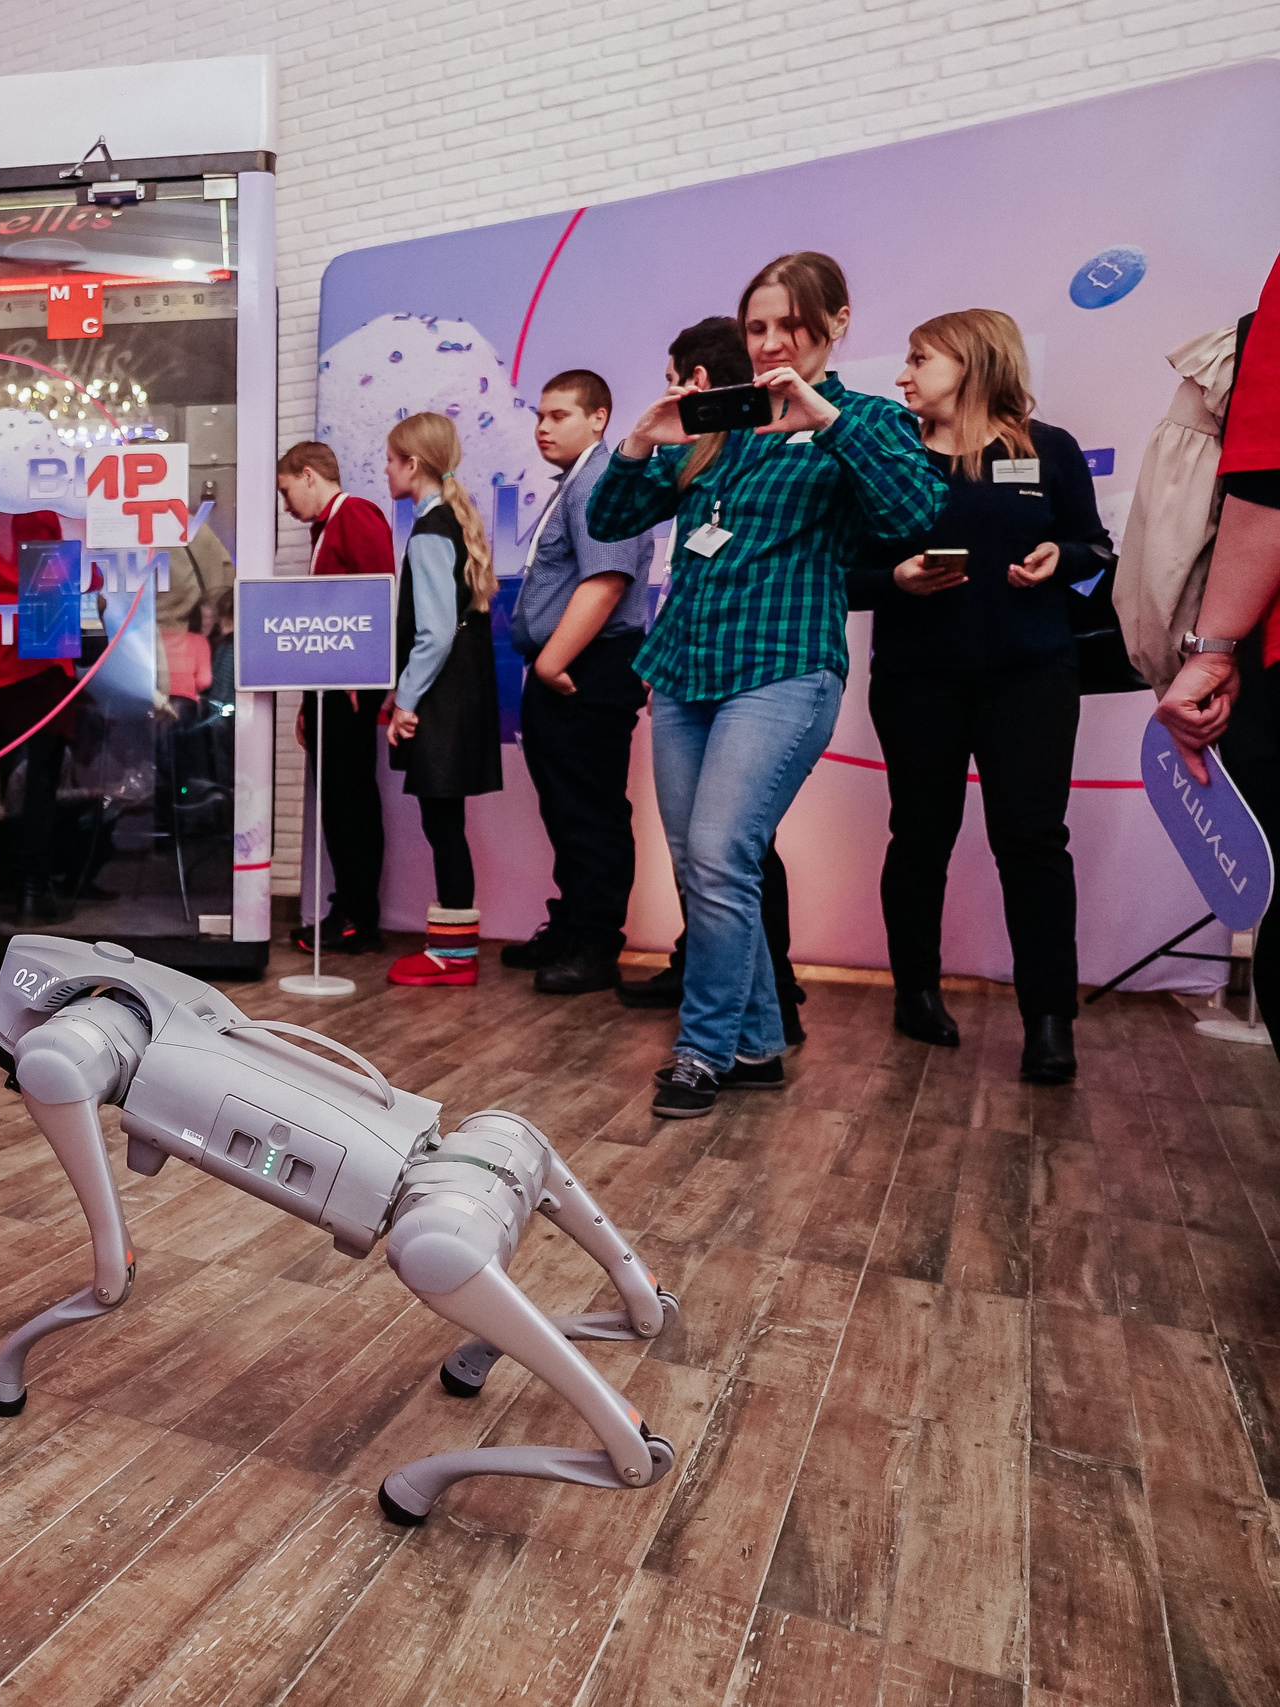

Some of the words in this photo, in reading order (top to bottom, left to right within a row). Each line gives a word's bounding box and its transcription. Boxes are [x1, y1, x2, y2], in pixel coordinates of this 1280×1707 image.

[264, 615, 372, 634] КАРАОКЕ
[277, 634, 355, 654] БУДКА
[1157, 751, 1171, 771] 7
[1173, 763, 1247, 894] ГРУППА
[13, 968, 38, 992] 02
